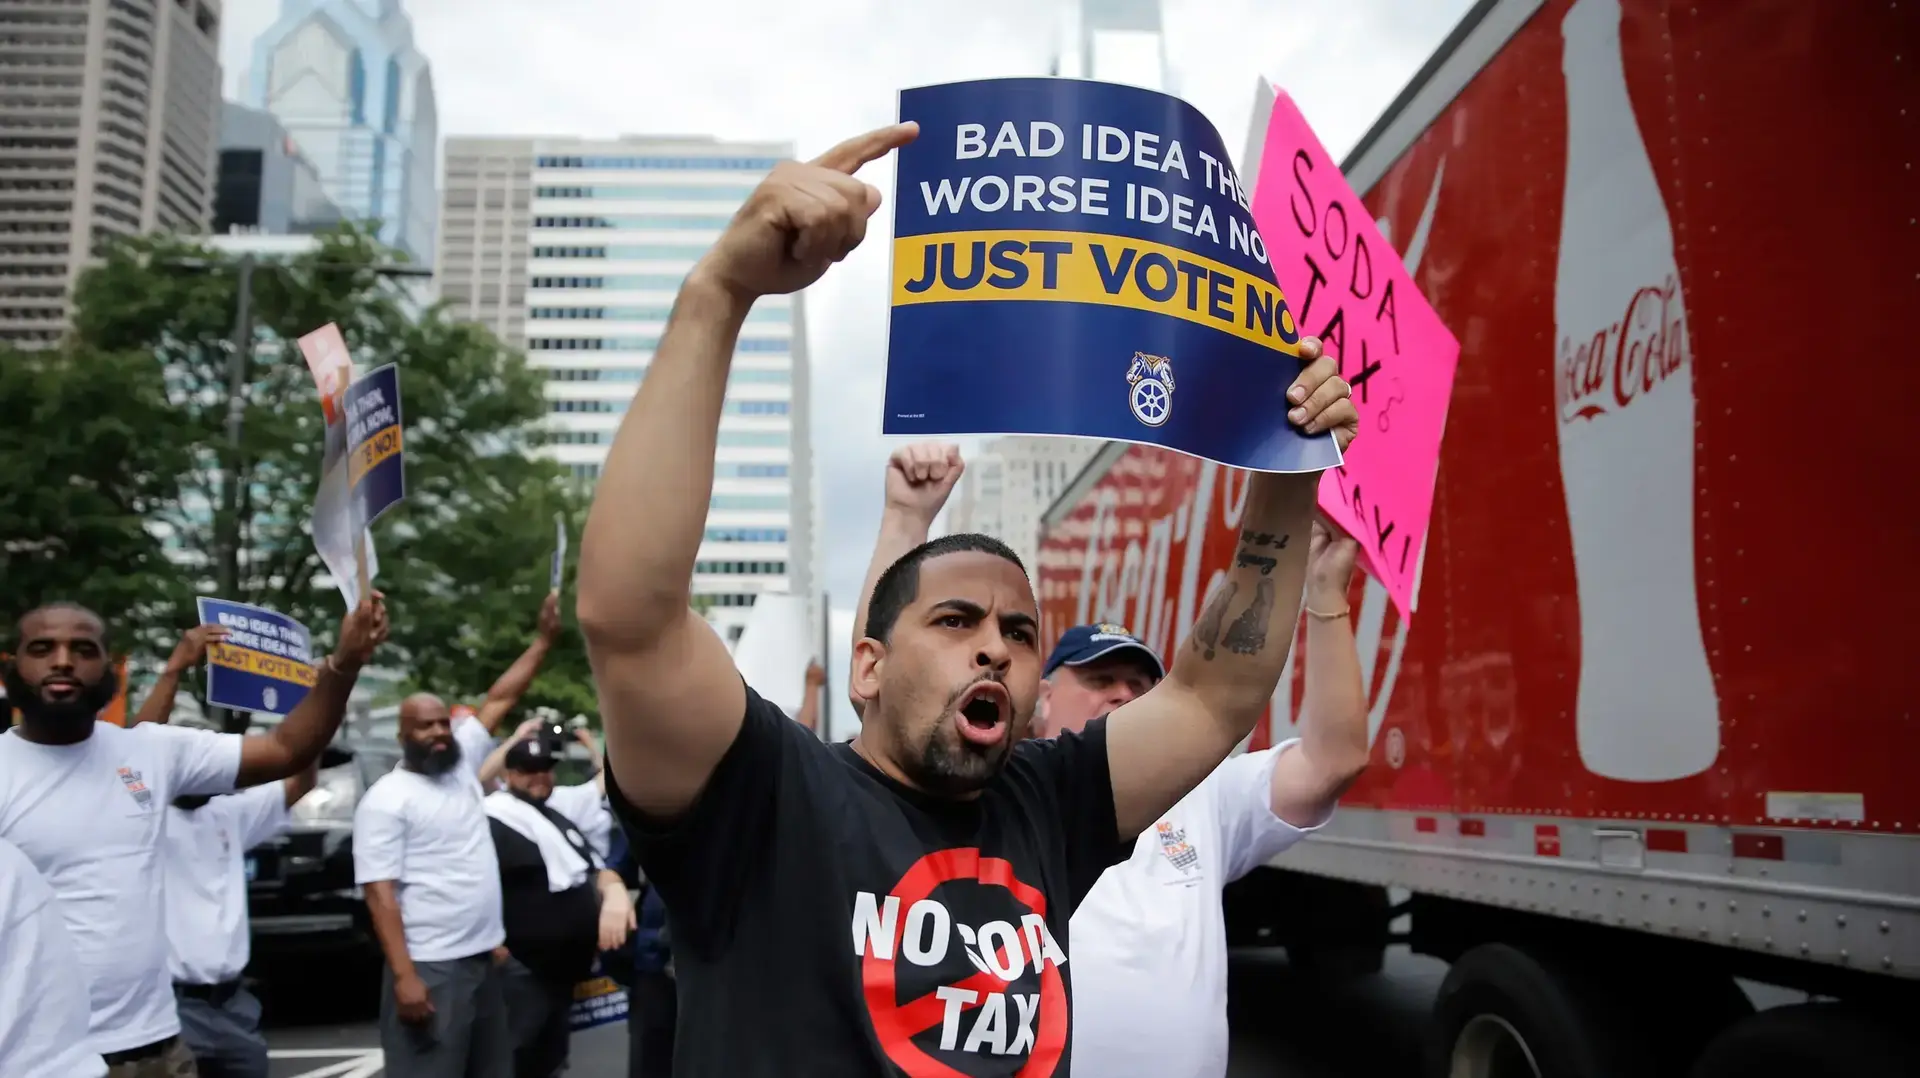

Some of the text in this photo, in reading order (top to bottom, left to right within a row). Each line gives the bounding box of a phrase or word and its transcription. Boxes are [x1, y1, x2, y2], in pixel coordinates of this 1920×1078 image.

[956, 122, 1252, 215] BAD IDEA THE
[920, 175, 1275, 275] WORSE IDEA NO
[1290, 148, 1400, 356] SODA
[904, 240, 1073, 295] JUST
[1088, 243, 1235, 323] VOTE
[852, 891, 951, 967] NO
[935, 985, 1040, 1056] TAX
